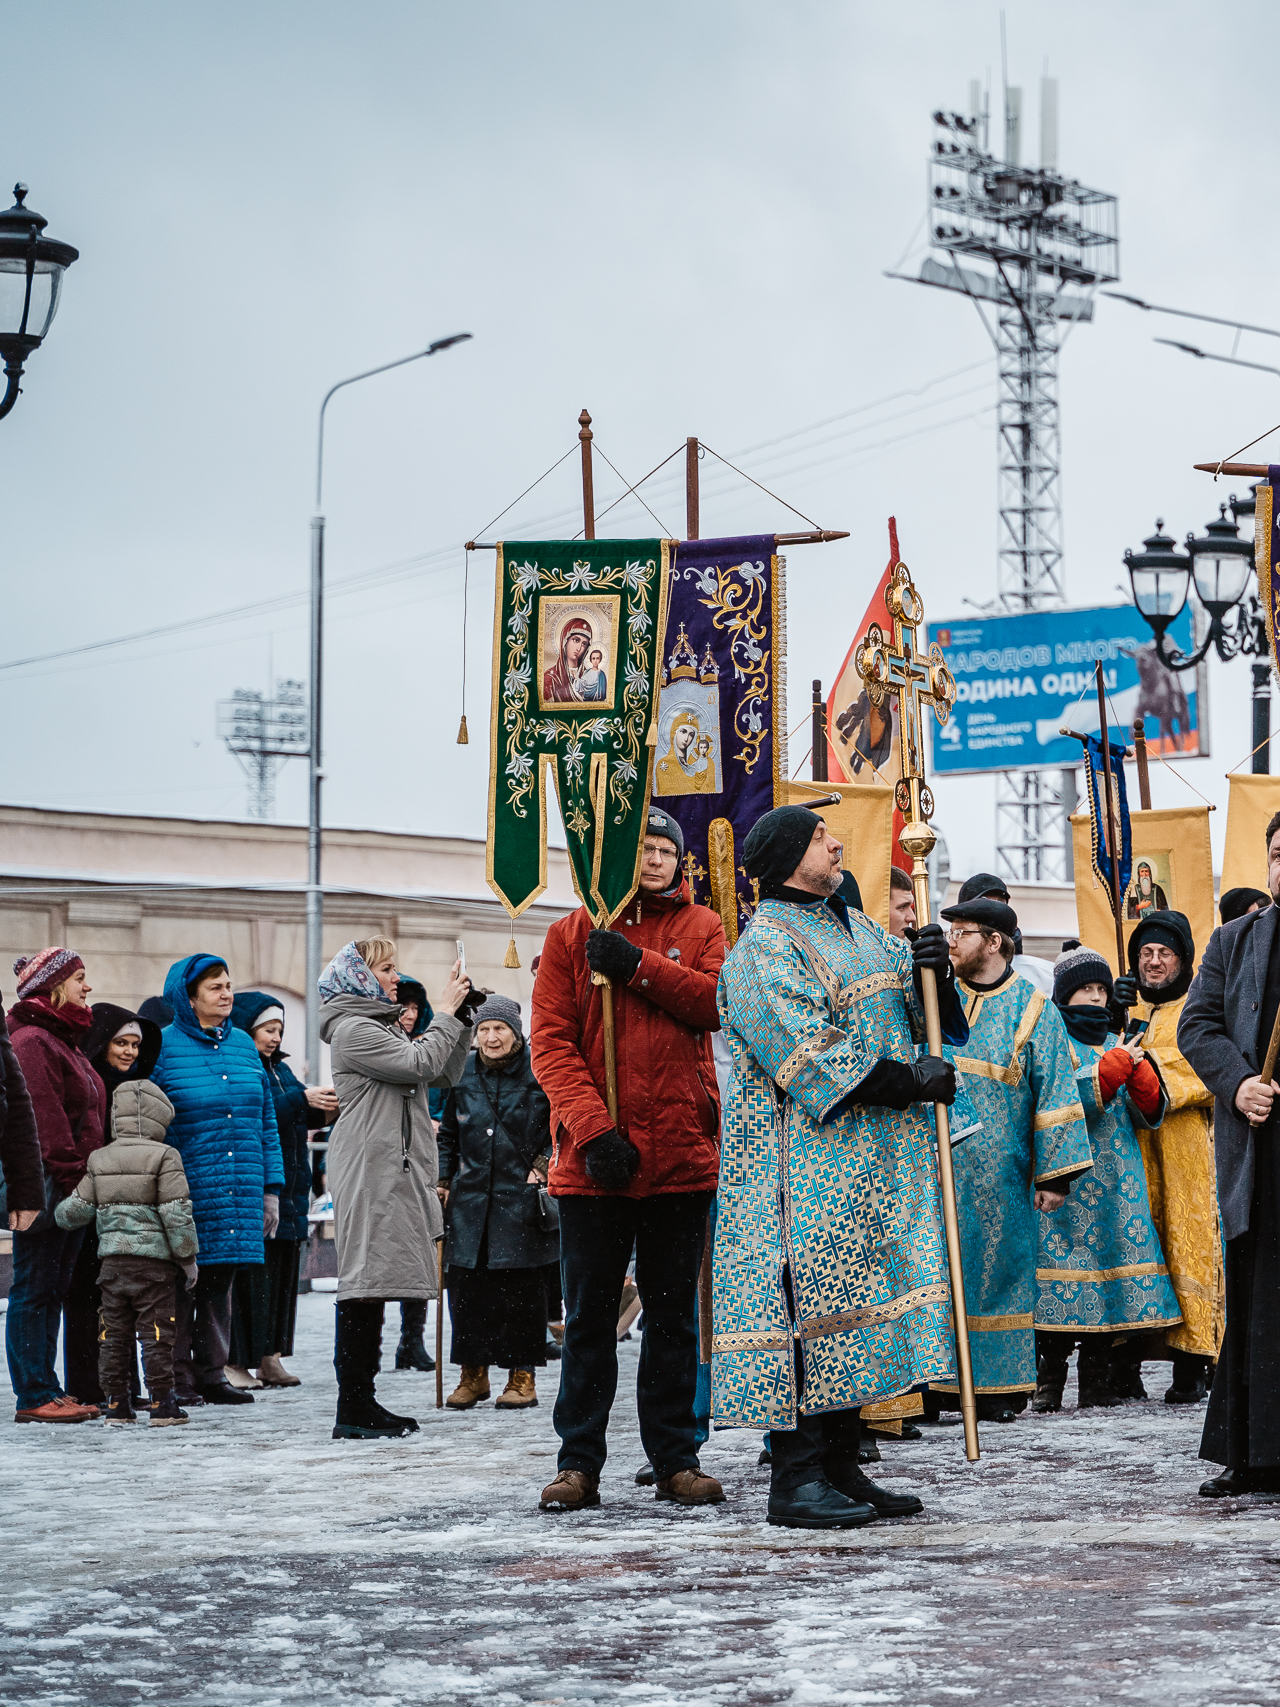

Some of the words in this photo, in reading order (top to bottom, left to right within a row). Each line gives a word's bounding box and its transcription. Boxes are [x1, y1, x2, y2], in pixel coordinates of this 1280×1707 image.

[1055, 635, 1139, 664] МНОГО
[956, 676, 1038, 704] ОДИНА
[1041, 667, 1117, 697] ОДНА!
[939, 714, 961, 743] 4
